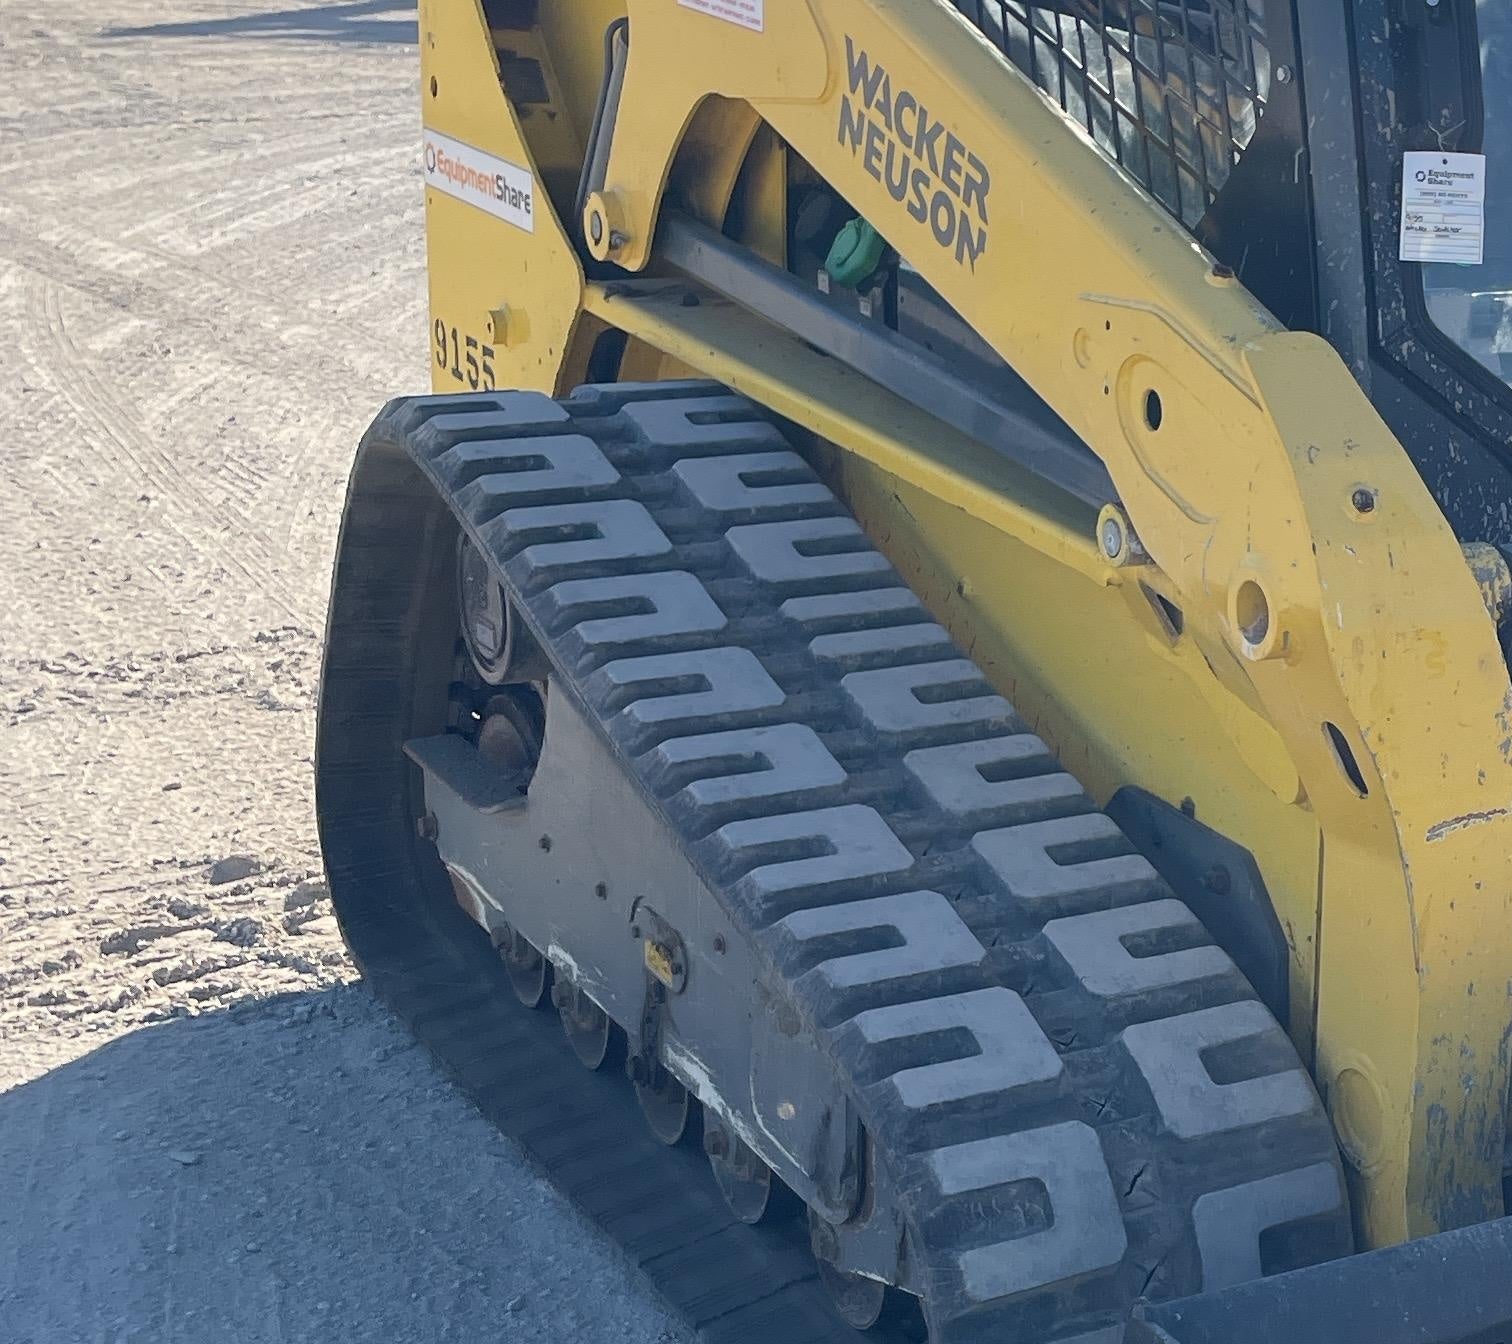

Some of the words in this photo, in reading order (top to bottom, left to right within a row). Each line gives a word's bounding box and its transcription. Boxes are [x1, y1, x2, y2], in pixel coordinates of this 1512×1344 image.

[844, 33, 991, 226] WACKER
[437, 148, 532, 216] EquipmentShare
[837, 93, 987, 277] NEUSON
[1427, 178, 1454, 187] Share
[1428, 169, 1475, 180] Equipment
[434, 317, 496, 392] 9155
